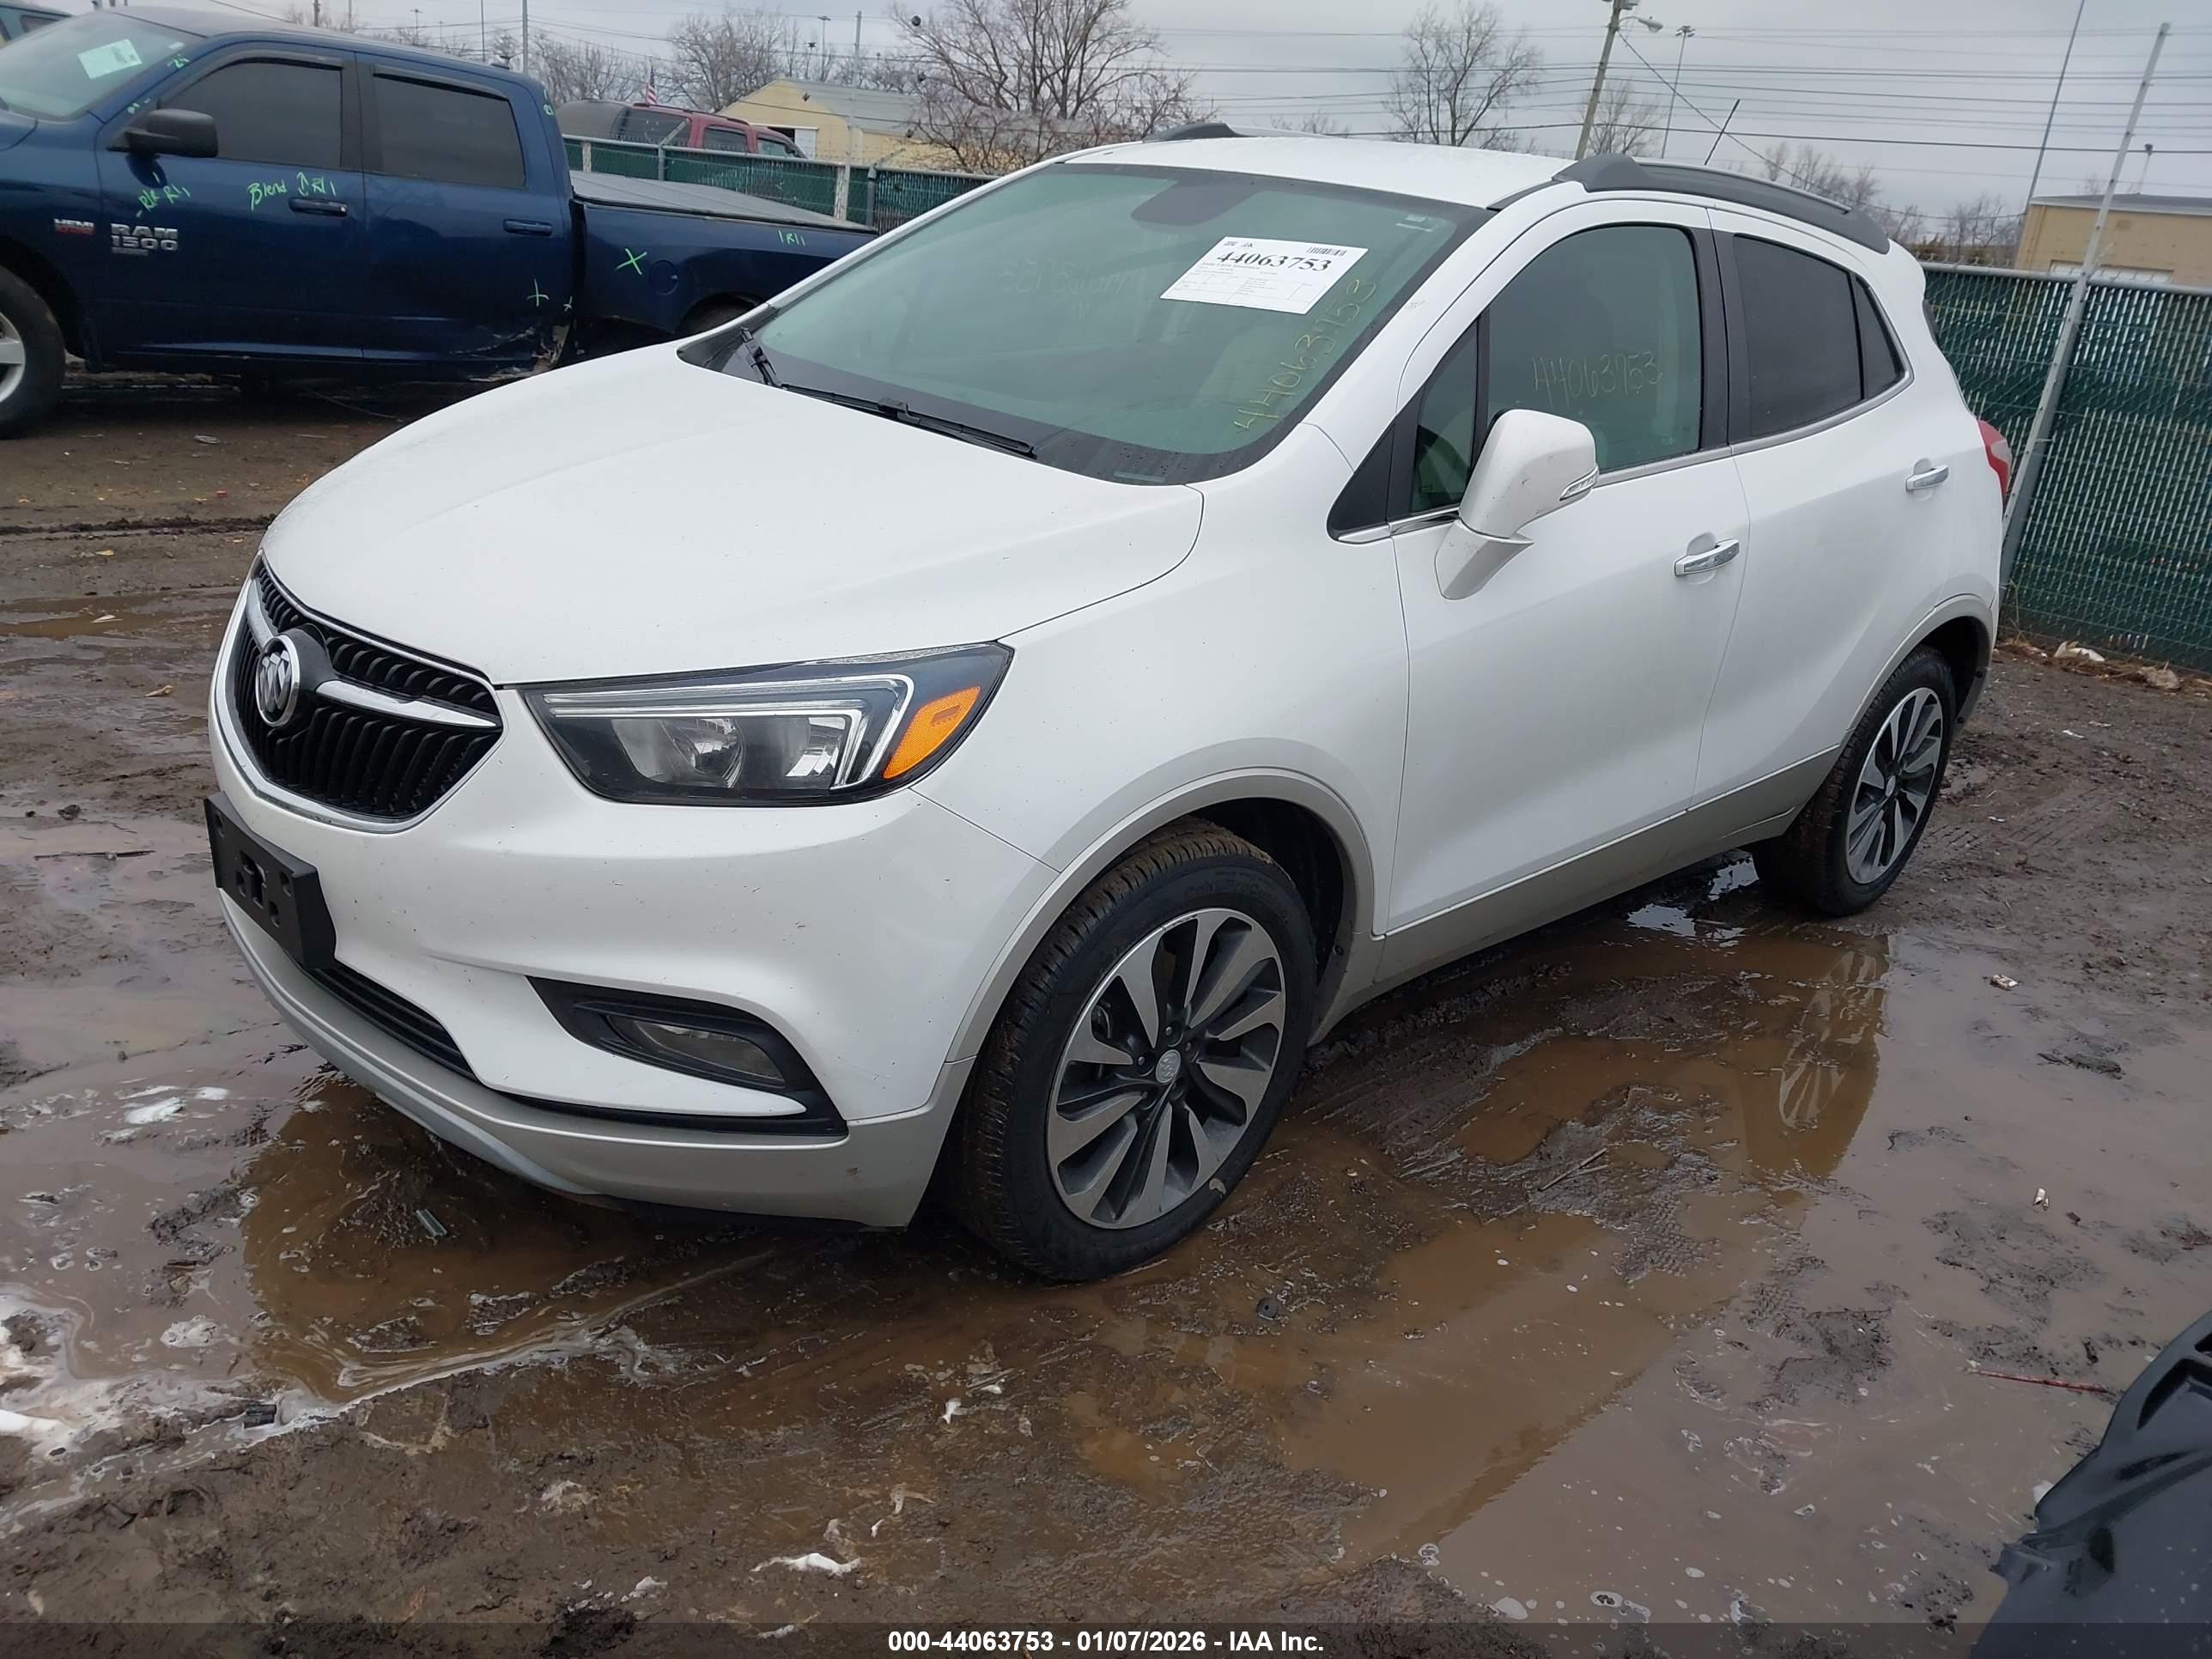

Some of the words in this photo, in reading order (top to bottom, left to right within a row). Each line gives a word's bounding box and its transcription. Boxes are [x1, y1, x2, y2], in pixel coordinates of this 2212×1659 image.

[247, 179, 288, 211] Blend
[111, 223, 179, 240] RAM
[111, 235, 179, 251] 1500
[1216, 251, 1332, 272] 44063753
[1532, 350, 1663, 409] 44063753
